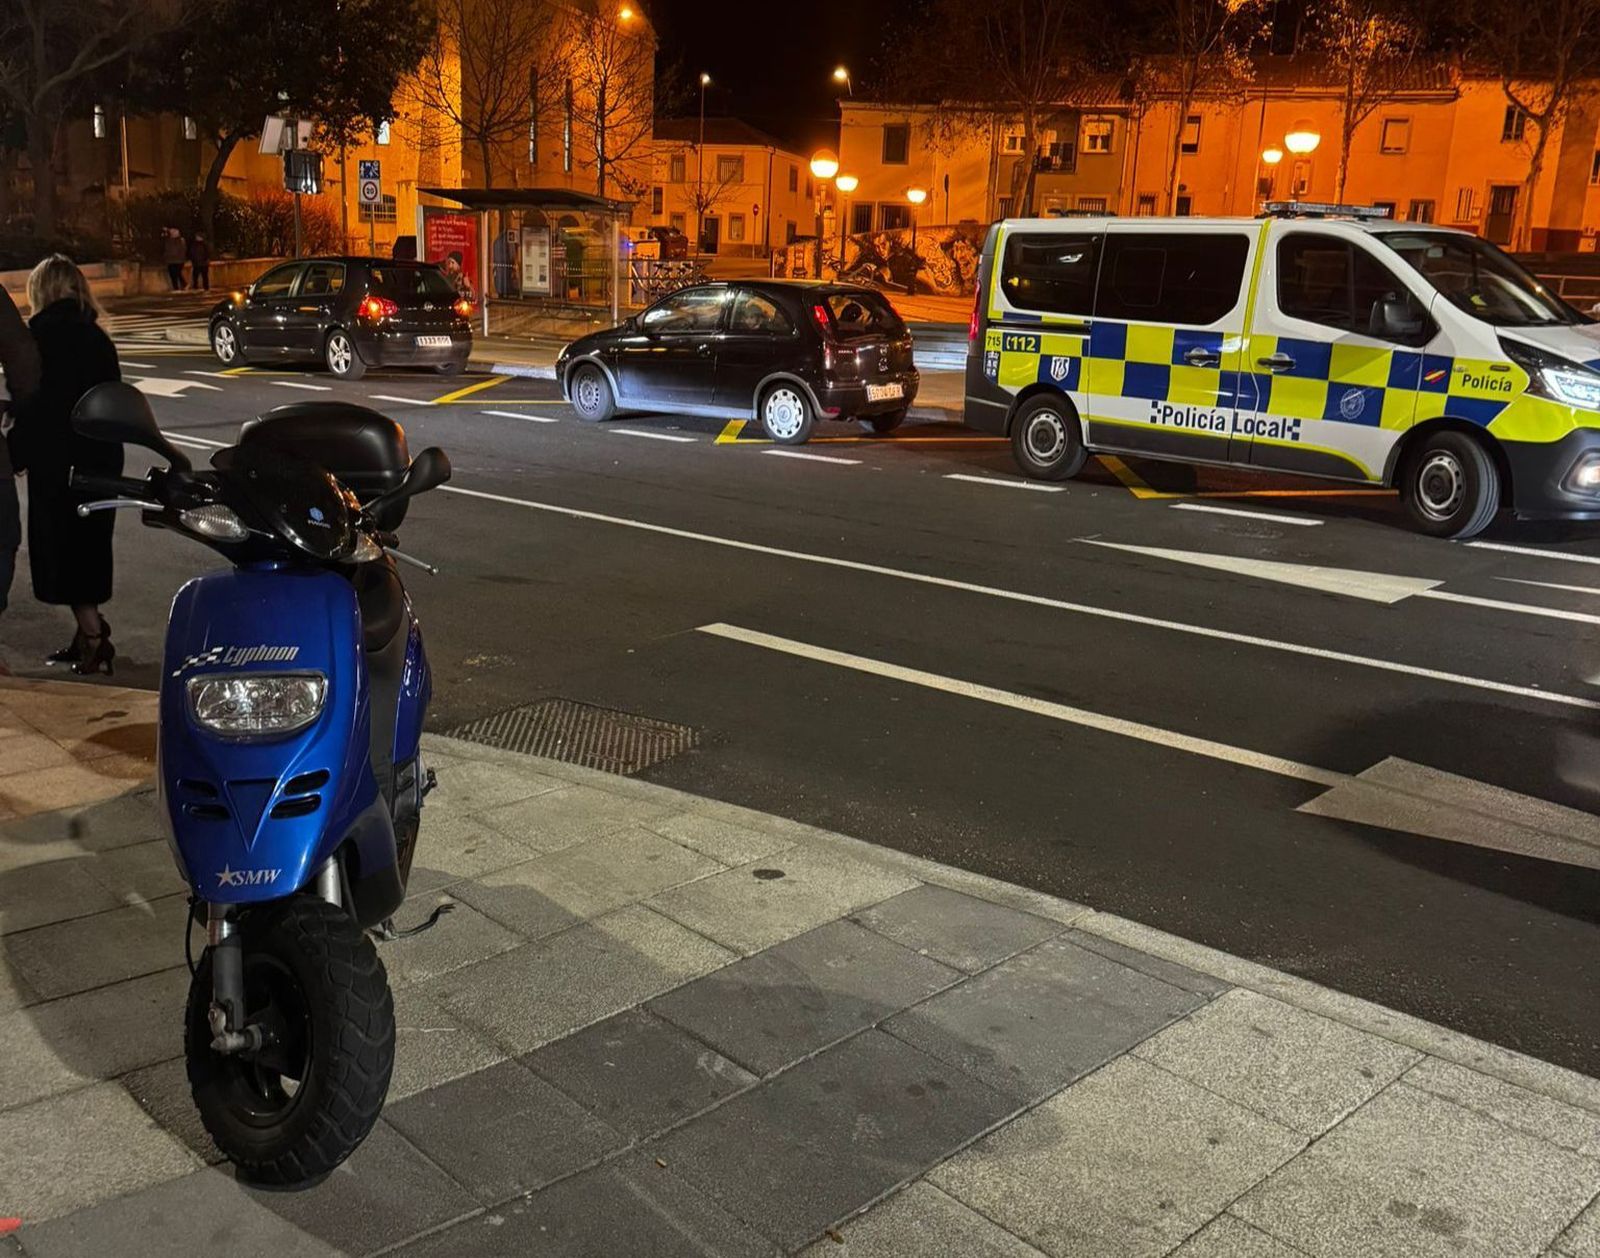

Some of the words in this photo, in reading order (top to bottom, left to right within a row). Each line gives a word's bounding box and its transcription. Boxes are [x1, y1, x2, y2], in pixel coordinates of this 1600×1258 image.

[987, 335, 1001, 347] 715
[1010, 336, 1036, 352] 112
[1462, 373, 1512, 392] Policía
[1161, 405, 1226, 432] Policía
[1232, 411, 1287, 439] Local
[222, 643, 300, 667] typhoon
[233, 868, 282, 886] SMW
